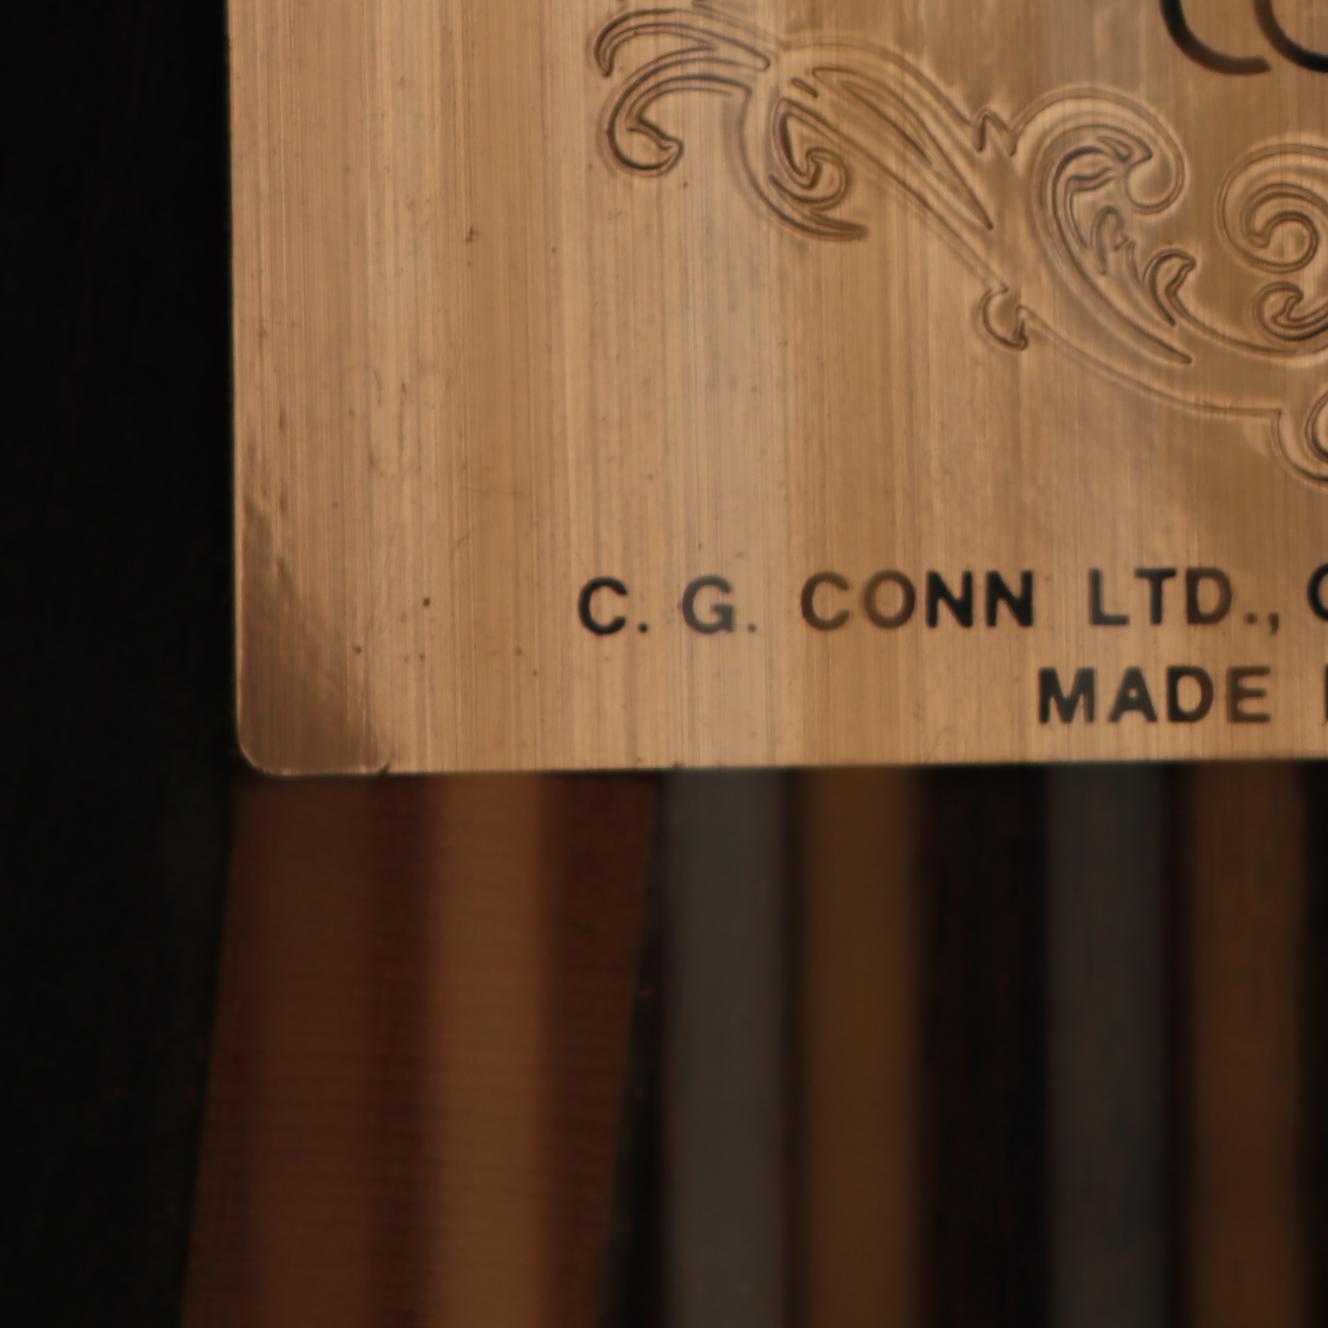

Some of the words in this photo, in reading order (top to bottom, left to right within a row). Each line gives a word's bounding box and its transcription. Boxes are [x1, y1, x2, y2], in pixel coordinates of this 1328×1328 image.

[578, 576, 650, 635] C.
[680, 575, 758, 635] G.
[800, 569, 1035, 631] CONN
[1087, 567, 1281, 636] LTD.,
[1038, 666, 1272, 725] MADE
